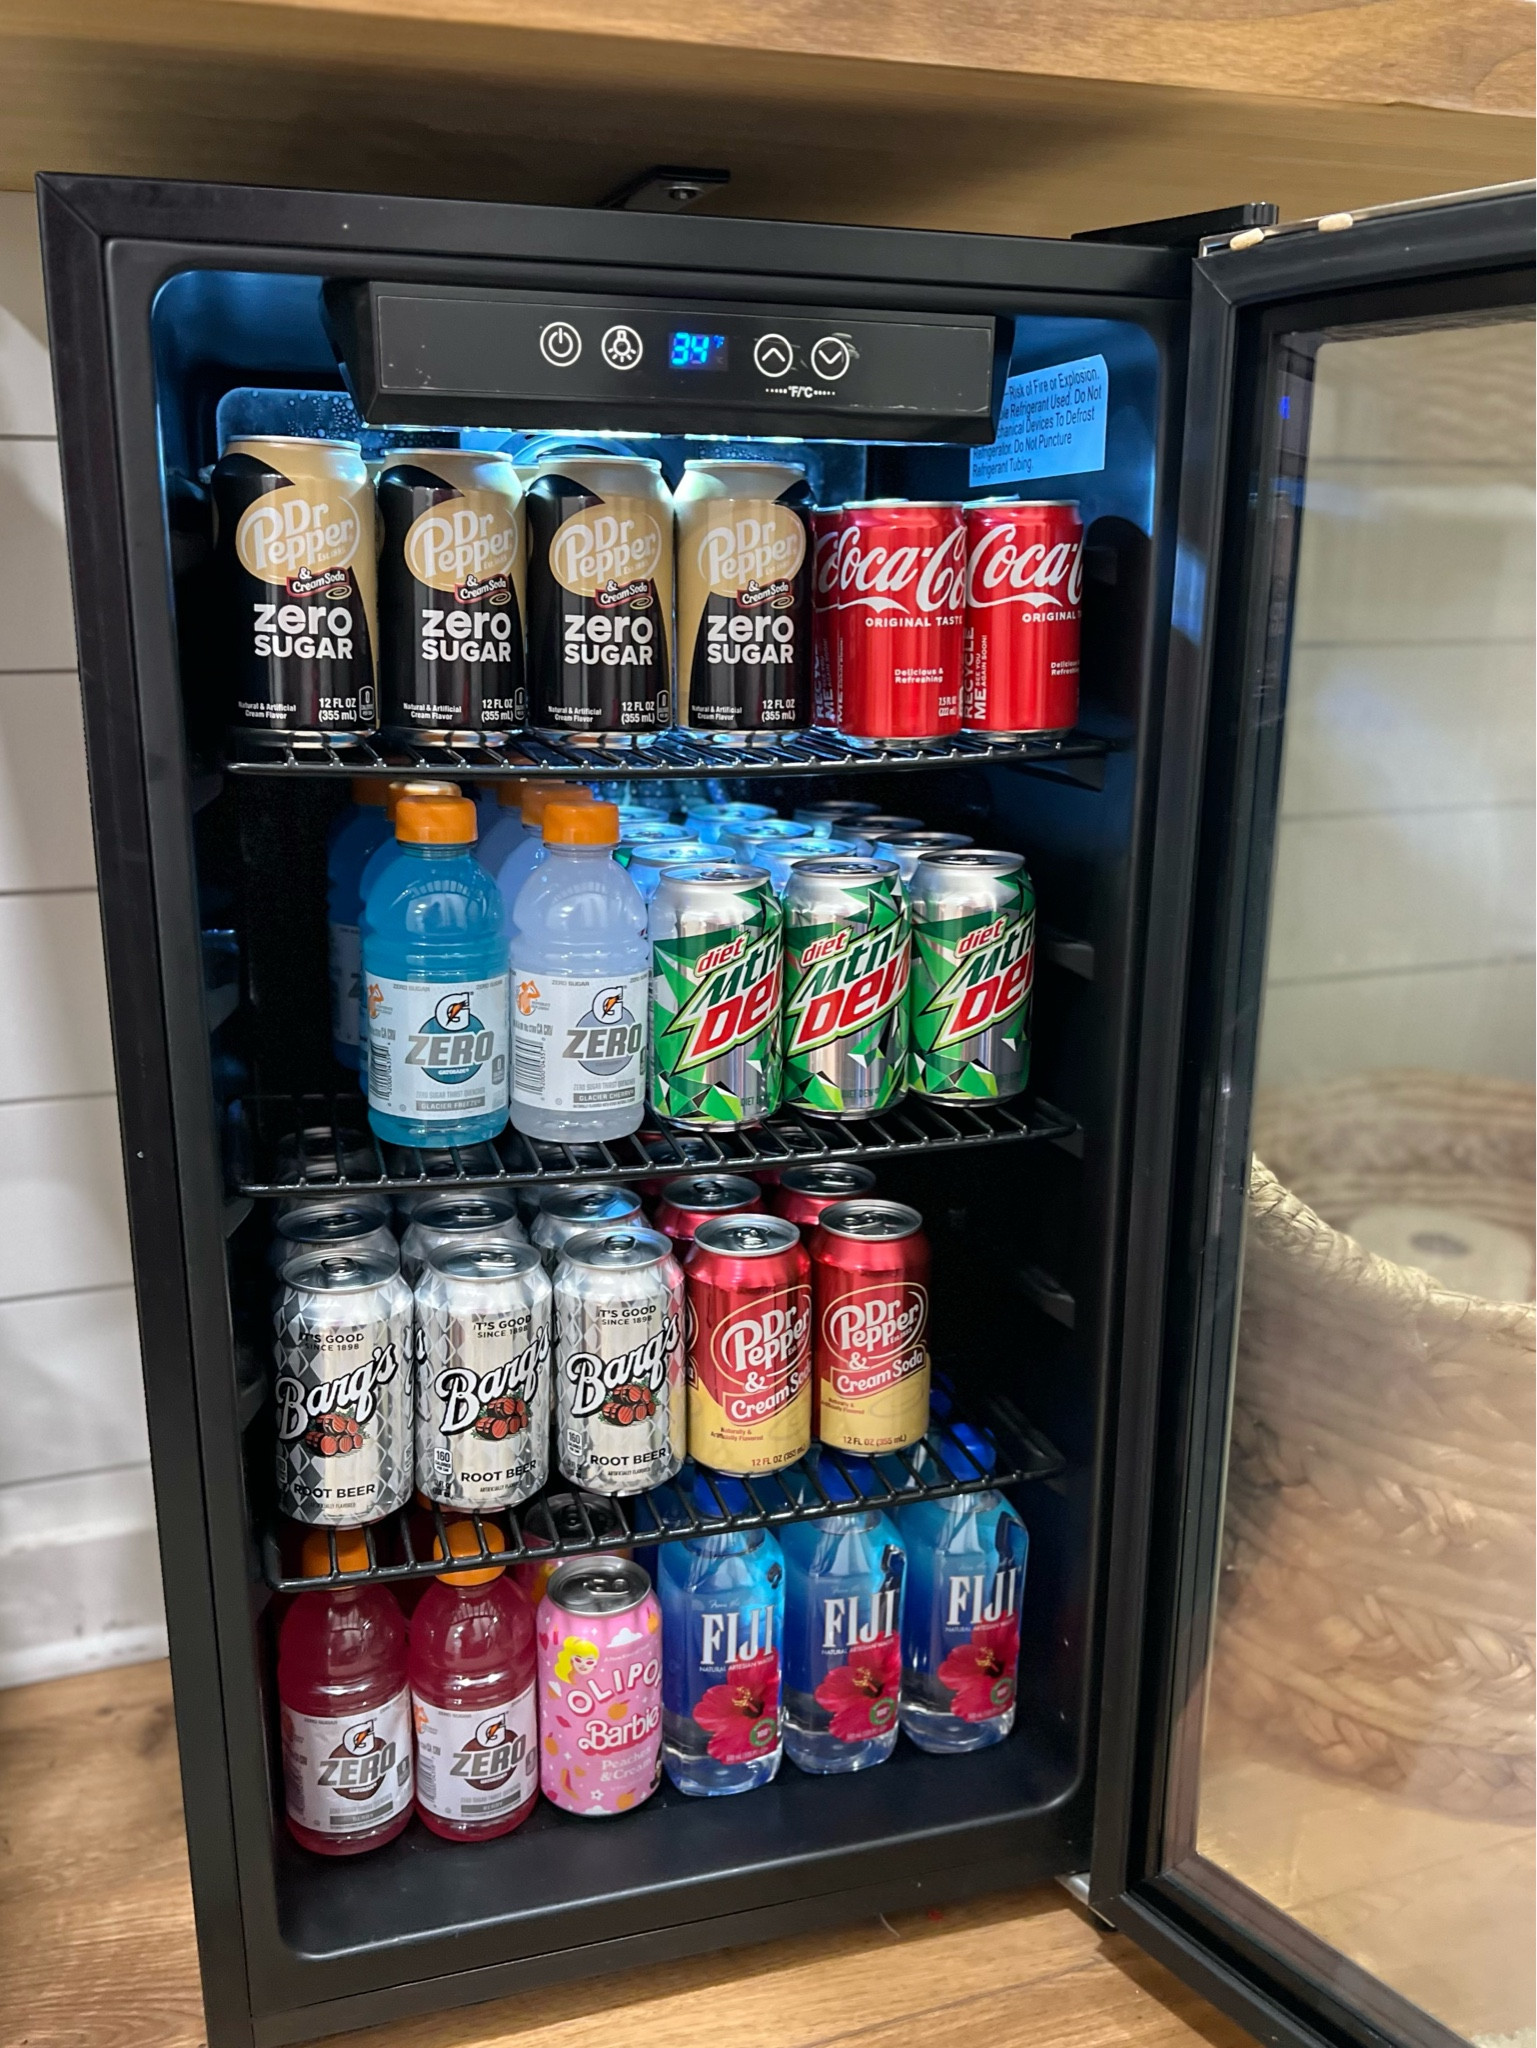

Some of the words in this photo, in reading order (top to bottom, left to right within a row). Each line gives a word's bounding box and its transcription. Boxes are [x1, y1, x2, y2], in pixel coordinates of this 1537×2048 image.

[671, 332, 710, 366] 34
[1026, 383, 1033, 396] of
[1033, 379, 1049, 394] Fire
[1050, 378, 1058, 391] or
[1058, 369, 1100, 389] Explosion.
[1010, 399, 1049, 418] Refrigerant
[1050, 393, 1072, 409] Used.
[1074, 389, 1086, 405] Do
[1087, 385, 1102, 400] Not
[1026, 416, 1054, 433] Devices
[1056, 411, 1065, 427] To
[1066, 407, 1095, 425] Defrost
[1014, 439, 1024, 454] Do
[1025, 436, 1039, 451] Not
[1040, 432, 1072, 448] Puncture
[973, 461, 1009, 479] Refrigerant
[1009, 457, 1034, 473] Tubing.
[283, 499, 329, 537] Dr
[452, 510, 493, 545] Dr
[243, 506, 354, 571] Pepper
[411, 517, 513, 579] Pepper
[594, 516, 634, 552] Dr
[736, 518, 776, 551] Dr
[556, 524, 656, 584] Pepper
[699, 526, 798, 586] Pepper
[292, 575, 325, 593] Cream
[325, 569, 345, 585] Soda
[299, 567, 312, 580] &
[466, 574, 479, 587] &
[606, 579, 618, 592] &
[748, 579, 760, 592] &
[459, 582, 489, 599] Cream
[488, 577, 506, 591] Soda
[600, 587, 630, 604] Cream
[629, 581, 647, 595] Soda
[742, 587, 771, 604] Cream
[771, 581, 789, 595] Soda
[254, 603, 353, 637] zero
[421, 609, 511, 641] zero
[564, 614, 653, 644] zero
[708, 614, 794, 643] zero
[865, 616, 931, 628] ORIGINAL
[936, 616, 963, 627] TASTE
[1022, 611, 1076, 623] ORIGINAL
[254, 635, 353, 660] SUGAR
[421, 640, 511, 662] SUGAR
[564, 644, 653, 666] SUGAR
[707, 643, 794, 664] SUGAR
[894, 668, 936, 677] Delicious
[938, 667, 944, 675] &
[894, 675, 943, 684] Refreshing
[963, 627, 974, 719] RECYCLE
[318, 709, 339, 722] (355
[341, 710, 357, 722] mL)
[319, 698, 331, 709] 12
[333, 698, 345, 709] FL
[345, 698, 356, 709] OZ
[403, 702, 426, 711] Natural
[426, 704, 432, 712] &
[433, 704, 462, 713] Artificial
[411, 711, 431, 720] Cream
[432, 712, 453, 721] Flavor
[481, 710, 499, 722] (355
[500, 710, 514, 722] mL)
[482, 699, 493, 709] 12
[494, 699, 503, 709] FL
[504, 699, 513, 709] OZ
[974, 687, 987, 720] ME
[802, 932, 848, 966] diet
[958, 920, 1004, 954] diet
[697, 937, 745, 973] diet
[796, 931, 894, 1002] Mtn
[688, 932, 782, 1015] Mtn
[435, 991, 470, 1032] G
[592, 985, 624, 1025] G
[405, 1030, 495, 1067] ZERO
[562, 1023, 643, 1060] ZERO
[421, 1099, 452, 1110] GLACIER
[578, 1092, 608, 1102] GLACIER
[498, 1314, 532, 1330] GOOD
[602, 1318, 630, 1326] SINCE
[633, 1316, 652, 1325] 1898
[622, 1305, 656, 1318] GOOD
[761, 1306, 797, 1343] Dr
[864, 1299, 901, 1328] Dr
[325, 1333, 365, 1343] GOOD
[477, 1330, 506, 1339] SINCE
[509, 1326, 528, 1335] 1898
[721, 1307, 810, 1372] Pepper
[830, 1304, 919, 1353] Pepper
[305, 1343, 333, 1352] SINCE
[337, 1343, 360, 1351] 1898
[848, 1351, 870, 1371] &
[434, 1322, 551, 1436] Barq's
[566, 1313, 680, 1418] Barq's
[837, 1369, 891, 1394] Cream
[892, 1350, 923, 1378] Soda
[275, 1343, 398, 1440] Barq's
[744, 1371, 766, 1393] &
[731, 1387, 790, 1420] Cream
[568, 1431, 581, 1445] 160
[843, 1435, 852, 1445] 12
[853, 1436, 863, 1445] FL
[864, 1437, 875, 1446] OZ
[436, 1449, 450, 1463] 160
[590, 1454, 629, 1466] ROOT
[633, 1448, 666, 1465] BEER
[461, 1471, 503, 1482] ROOT
[506, 1460, 536, 1479] BEER
[294, 1485, 332, 1498] ROOT
[337, 1484, 375, 1498] BEER
[946, 1568, 1016, 1625] FIJI
[822, 1590, 894, 1648] FIJI
[701, 1605, 774, 1665] FIJI
[567, 1658, 662, 1715] OLIPO
[343, 1719, 375, 1756] G
[475, 1712, 506, 1748] G
[578, 1705, 660, 1751] Barbie
[318, 1741, 396, 1786] ZERO
[450, 1734, 527, 1777] ZERO
[600, 1771, 612, 1782] &
[613, 1758, 652, 1779] Cream
